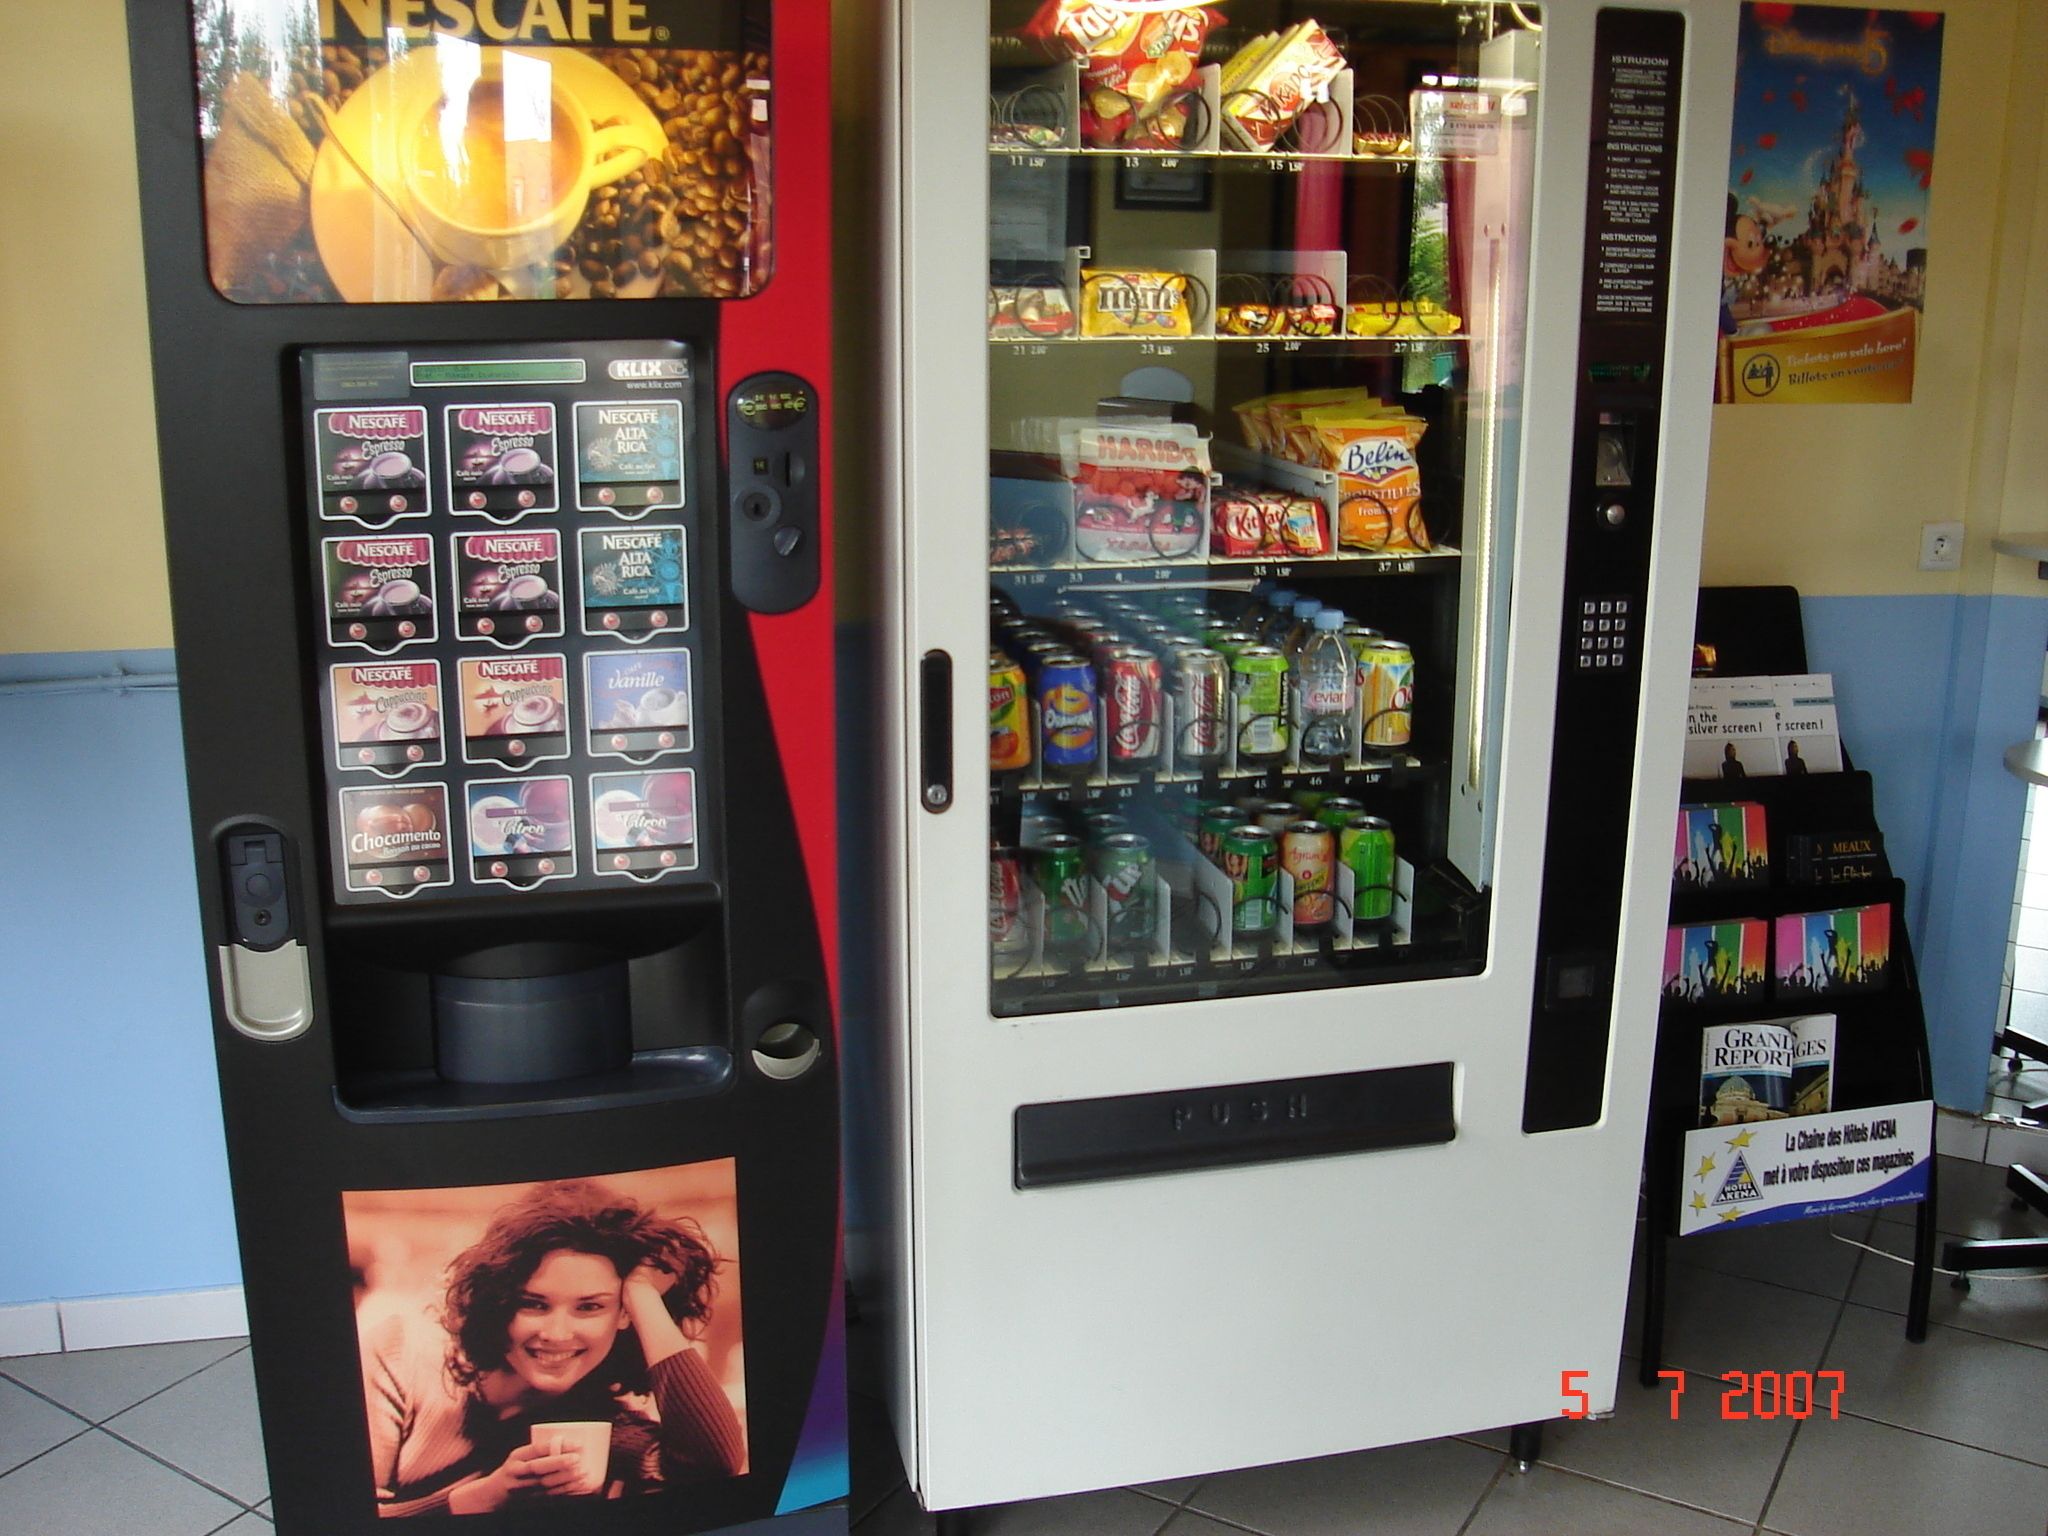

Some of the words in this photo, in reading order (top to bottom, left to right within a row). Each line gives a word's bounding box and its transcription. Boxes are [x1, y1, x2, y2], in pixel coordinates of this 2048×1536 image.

[1612, 55, 1669, 66] ISTRUZIONI
[1606, 143, 1663, 153] INSTRUCTIONS
[1125, 156, 1139, 168] 13
[1270, 160, 1284, 170] 15
[1396, 162, 1409, 173] 17
[1601, 233, 1658, 243] INSTRUCTIONS
[1141, 344, 1154, 354] 23
[1256, 343, 1270, 353] 25
[1394, 342, 1408, 353] 27
[617, 361, 662, 377] KLIX
[626, 381, 683, 390] www.klix.com
[1788, 373, 1828, 386] Billets
[349, 414, 409, 429] NESCAFÉ
[479, 410, 536, 426] NESCAFÉ
[598, 408, 660, 425] NESCAFÉ
[615, 427, 648, 441] ALTA
[361, 440, 406, 460] Espresso
[491, 436, 534, 456] Espresso
[617, 440, 648, 454] RICA
[1347, 442, 1411, 473] Belin
[485, 538, 544, 552] NESCAFÉ
[602, 533, 663, 550] NESCAFÉ
[357, 541, 416, 557] NESCAFÉ
[619, 551, 652, 566] ALTA
[498, 563, 541, 584] Espresso
[622, 565, 651, 579] RICA
[1253, 565, 1267, 576] 35
[1378, 562, 1391, 572] 37
[370, 568, 413, 588] Espresso
[355, 666, 413, 682] NESCAFÉ
[482, 660, 539, 676] NESCAFÉ
[376, 691, 428, 713] Cappuccino
[503, 685, 553, 707] Cappuccino
[1314, 691, 1346, 703] evian
[1700, 712, 1718, 723] the
[1688, 723, 1718, 735] silver
[1254, 779, 1267, 789] 45
[1309, 776, 1323, 786] 46
[1184, 784, 1198, 794] 44
[502, 819, 546, 836] Citron
[623, 813, 668, 830] Citron
[351, 829, 442, 854] Chocamento
[1833, 840, 1872, 853] MEAUX
[1785, 1132, 1796, 1153] La
[1827, 1126, 1842, 1146] des
[1843, 1121, 1869, 1144] Hôtels
[1870, 1118, 1897, 1141] AKENA
[1763, 1169, 1780, 1187] met
[1781, 1163, 1787, 1184] à
[1789, 1162, 1810, 1184] votre
[1811, 1156, 1856, 1184] disposition
[1857, 1156, 1871, 1173] ces
[1872, 1149, 1915, 1175] magazines
[1724, 1183, 1753, 1193] HOTEL
[1718, 1189, 1758, 1202] AKENA
